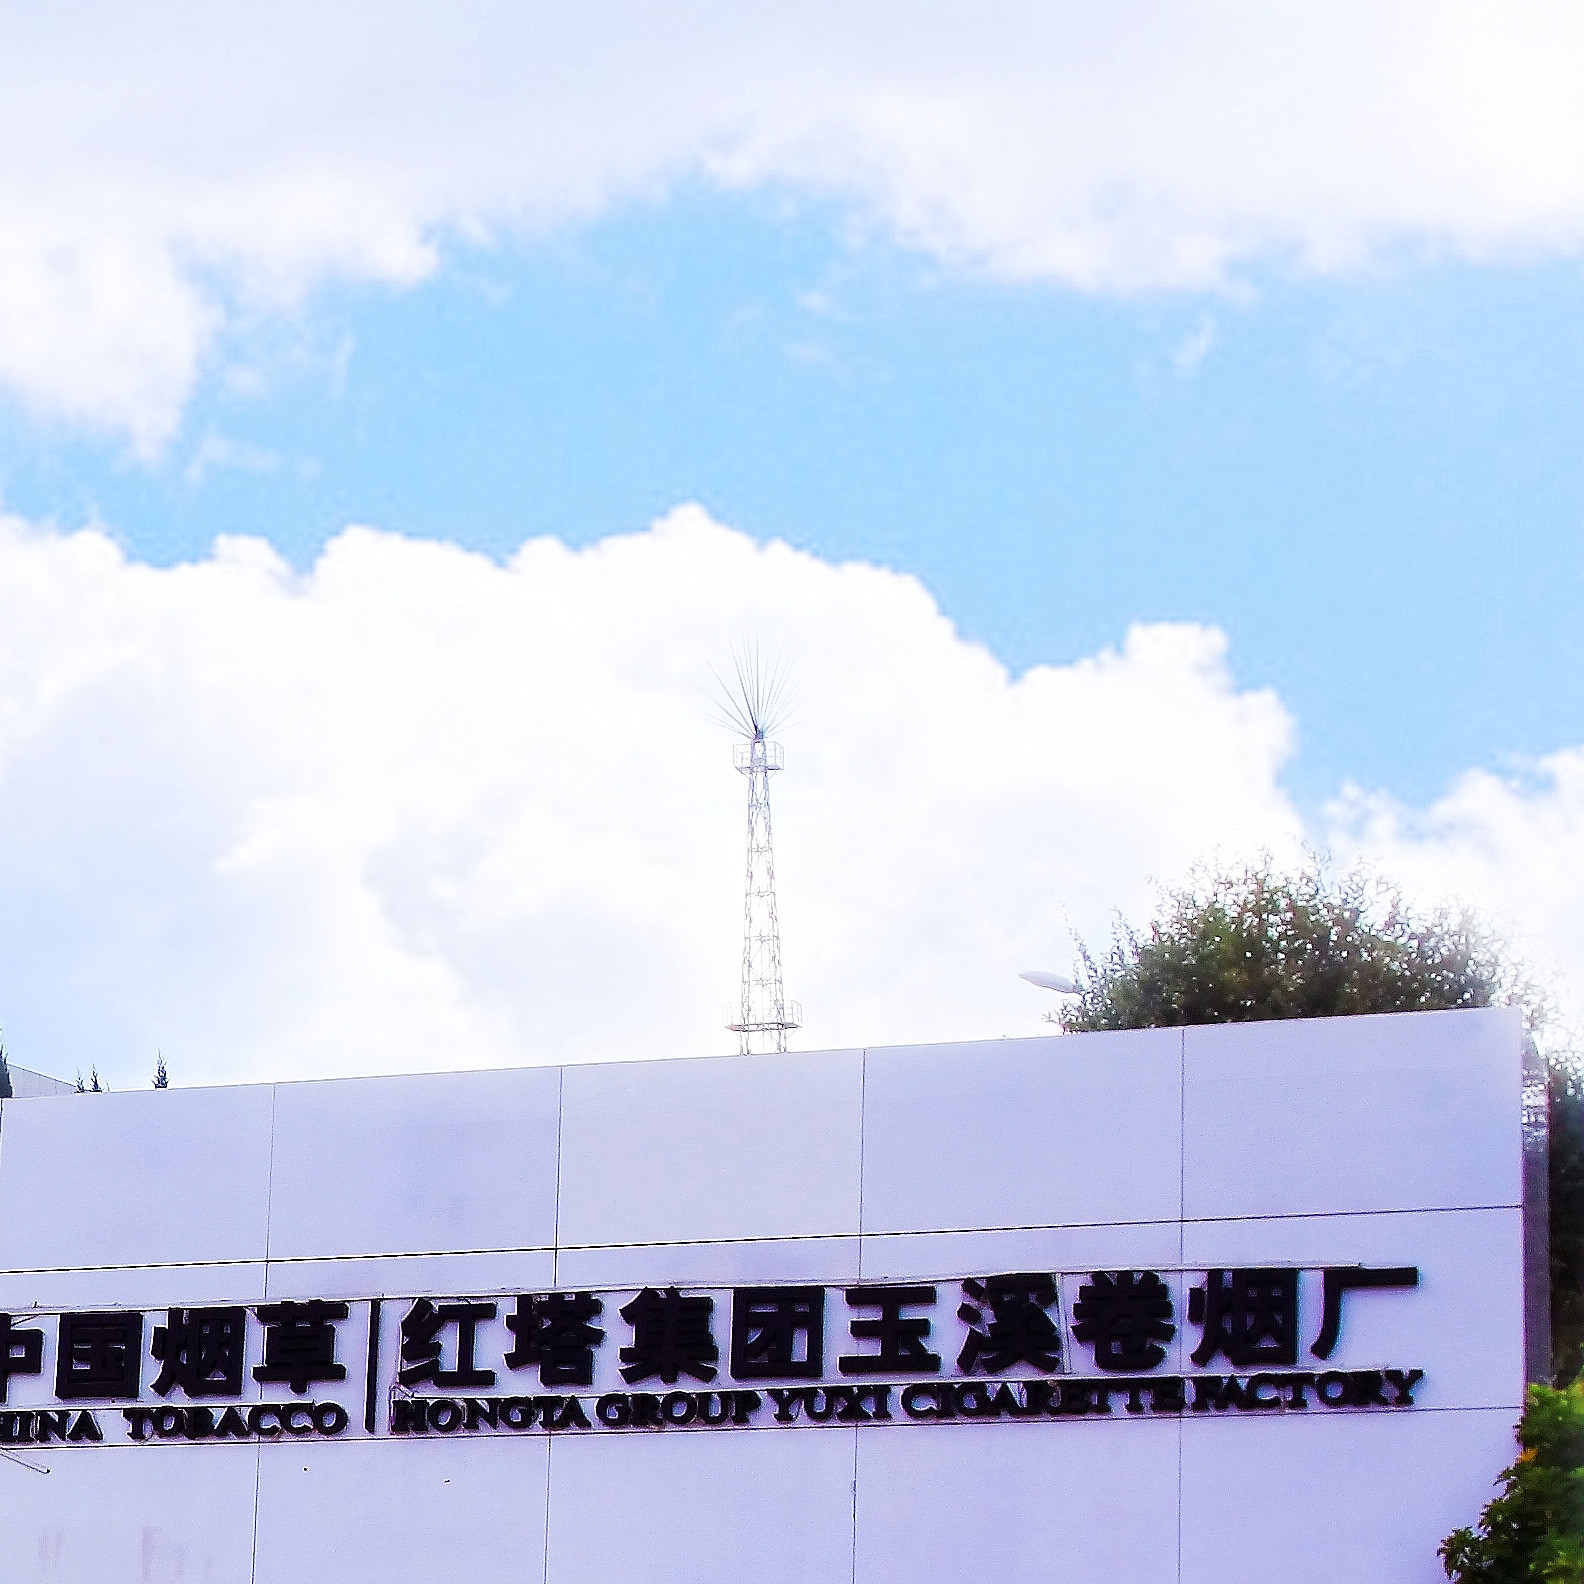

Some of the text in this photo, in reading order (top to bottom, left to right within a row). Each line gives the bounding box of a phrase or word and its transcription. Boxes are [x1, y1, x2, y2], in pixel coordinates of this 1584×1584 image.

[398, 1266, 1420, 1387] 红塔集团玉溪卷烟厂
[122, 1402, 349, 1440] TOBACCO
[390, 1369, 1424, 1434] HONGTA GROUP YUXI CIGARETTE FACTORY
